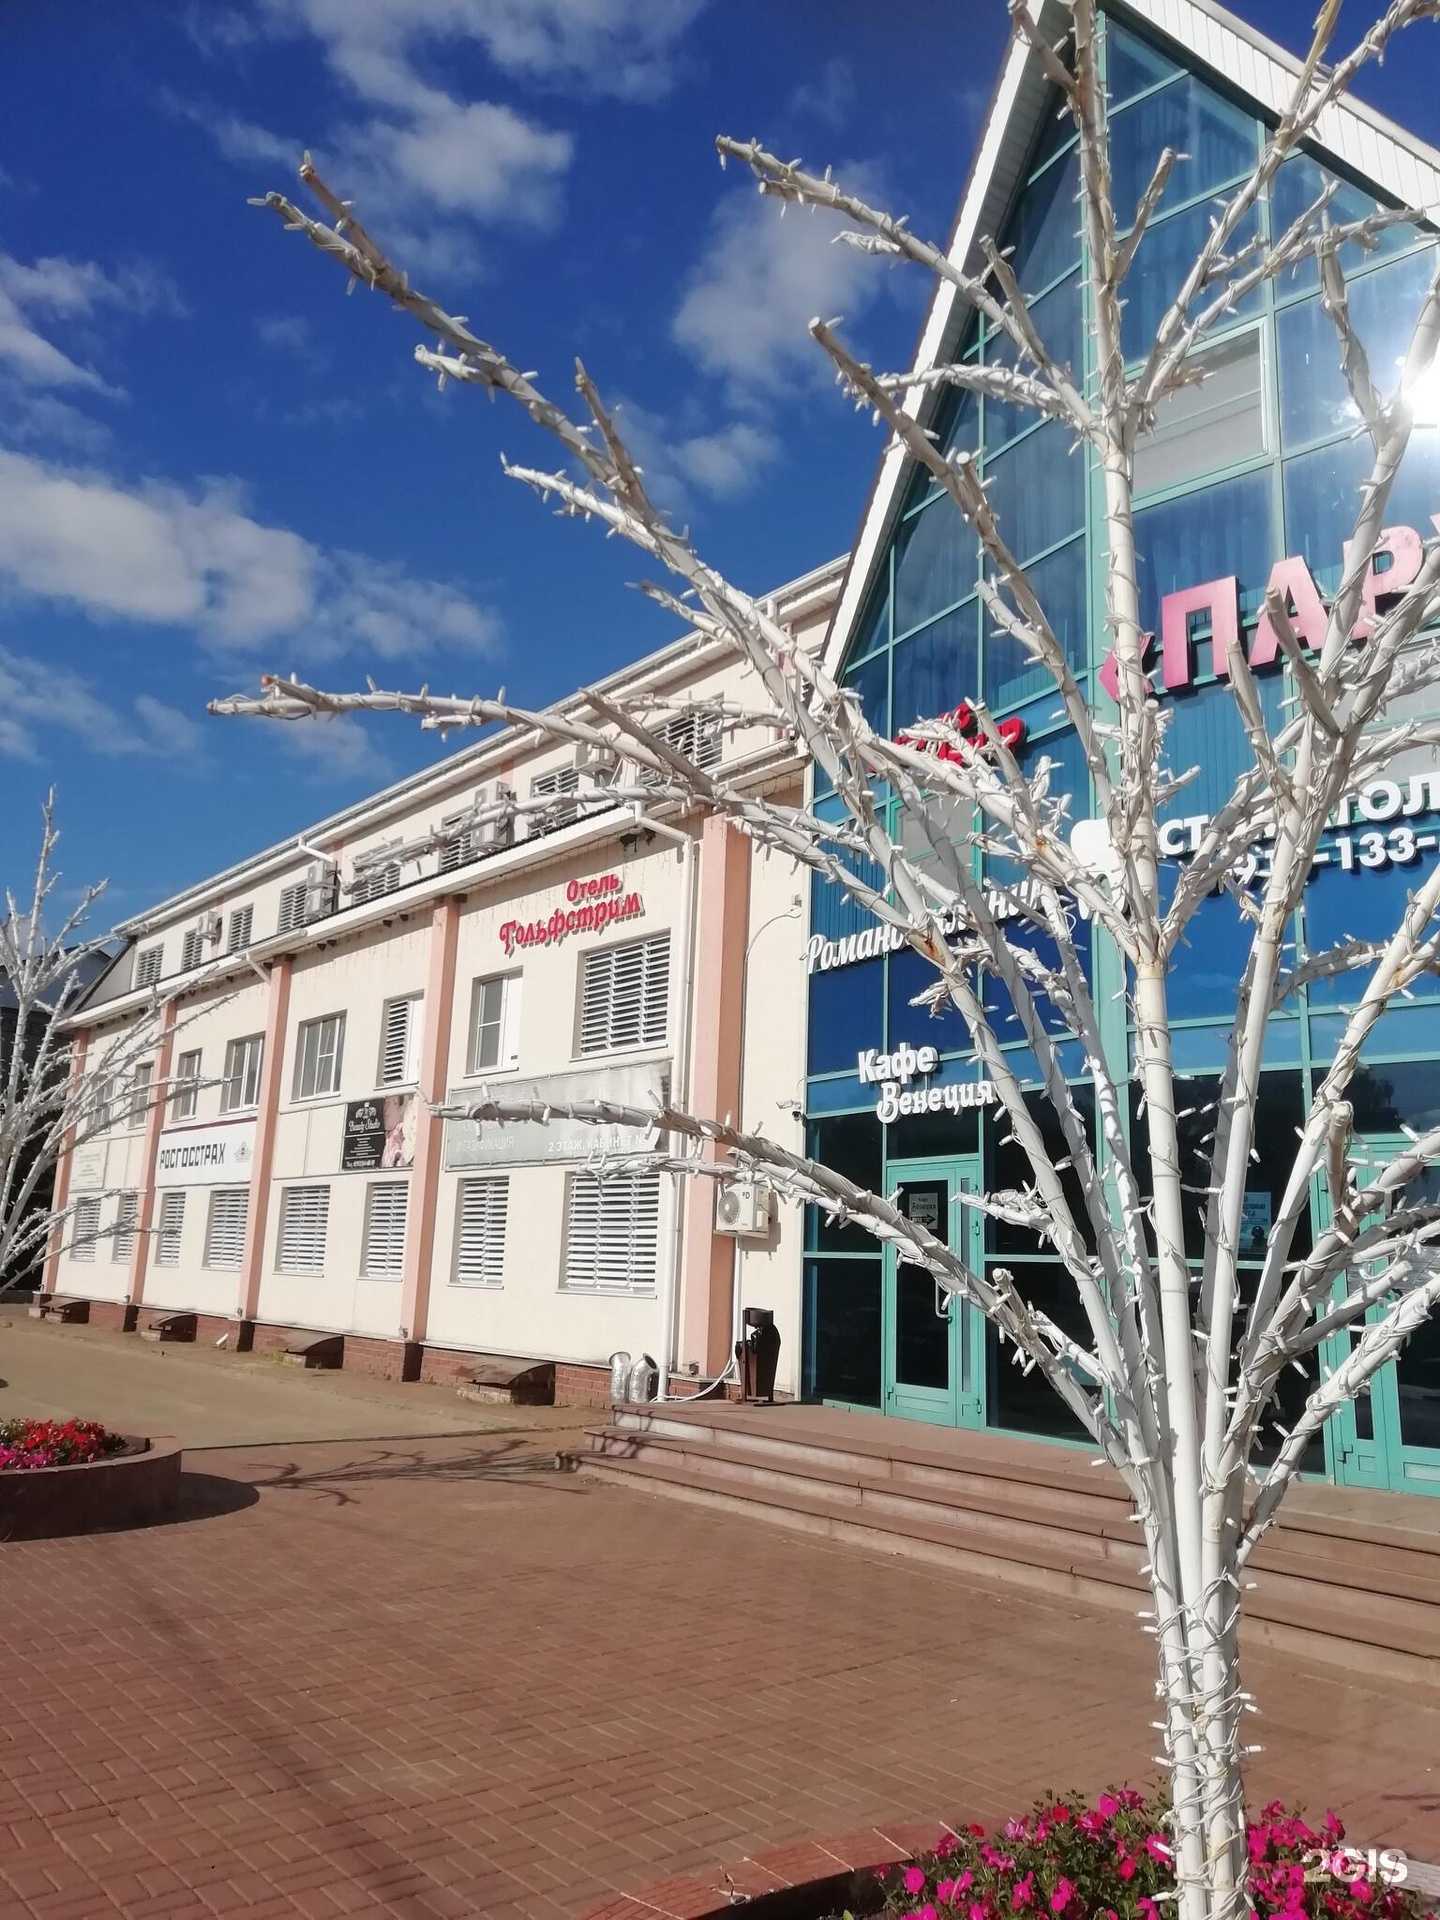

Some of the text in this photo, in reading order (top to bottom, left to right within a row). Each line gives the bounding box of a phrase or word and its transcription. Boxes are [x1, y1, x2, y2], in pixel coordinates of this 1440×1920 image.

[566, 874, 621, 902] Отель
[499, 892, 643, 955] Гольфстрим
[858, 1042, 938, 1084] Кафе
[876, 1080, 994, 1124] Венеция
[159, 1142, 227, 1169] РОСГОССТРАХ
